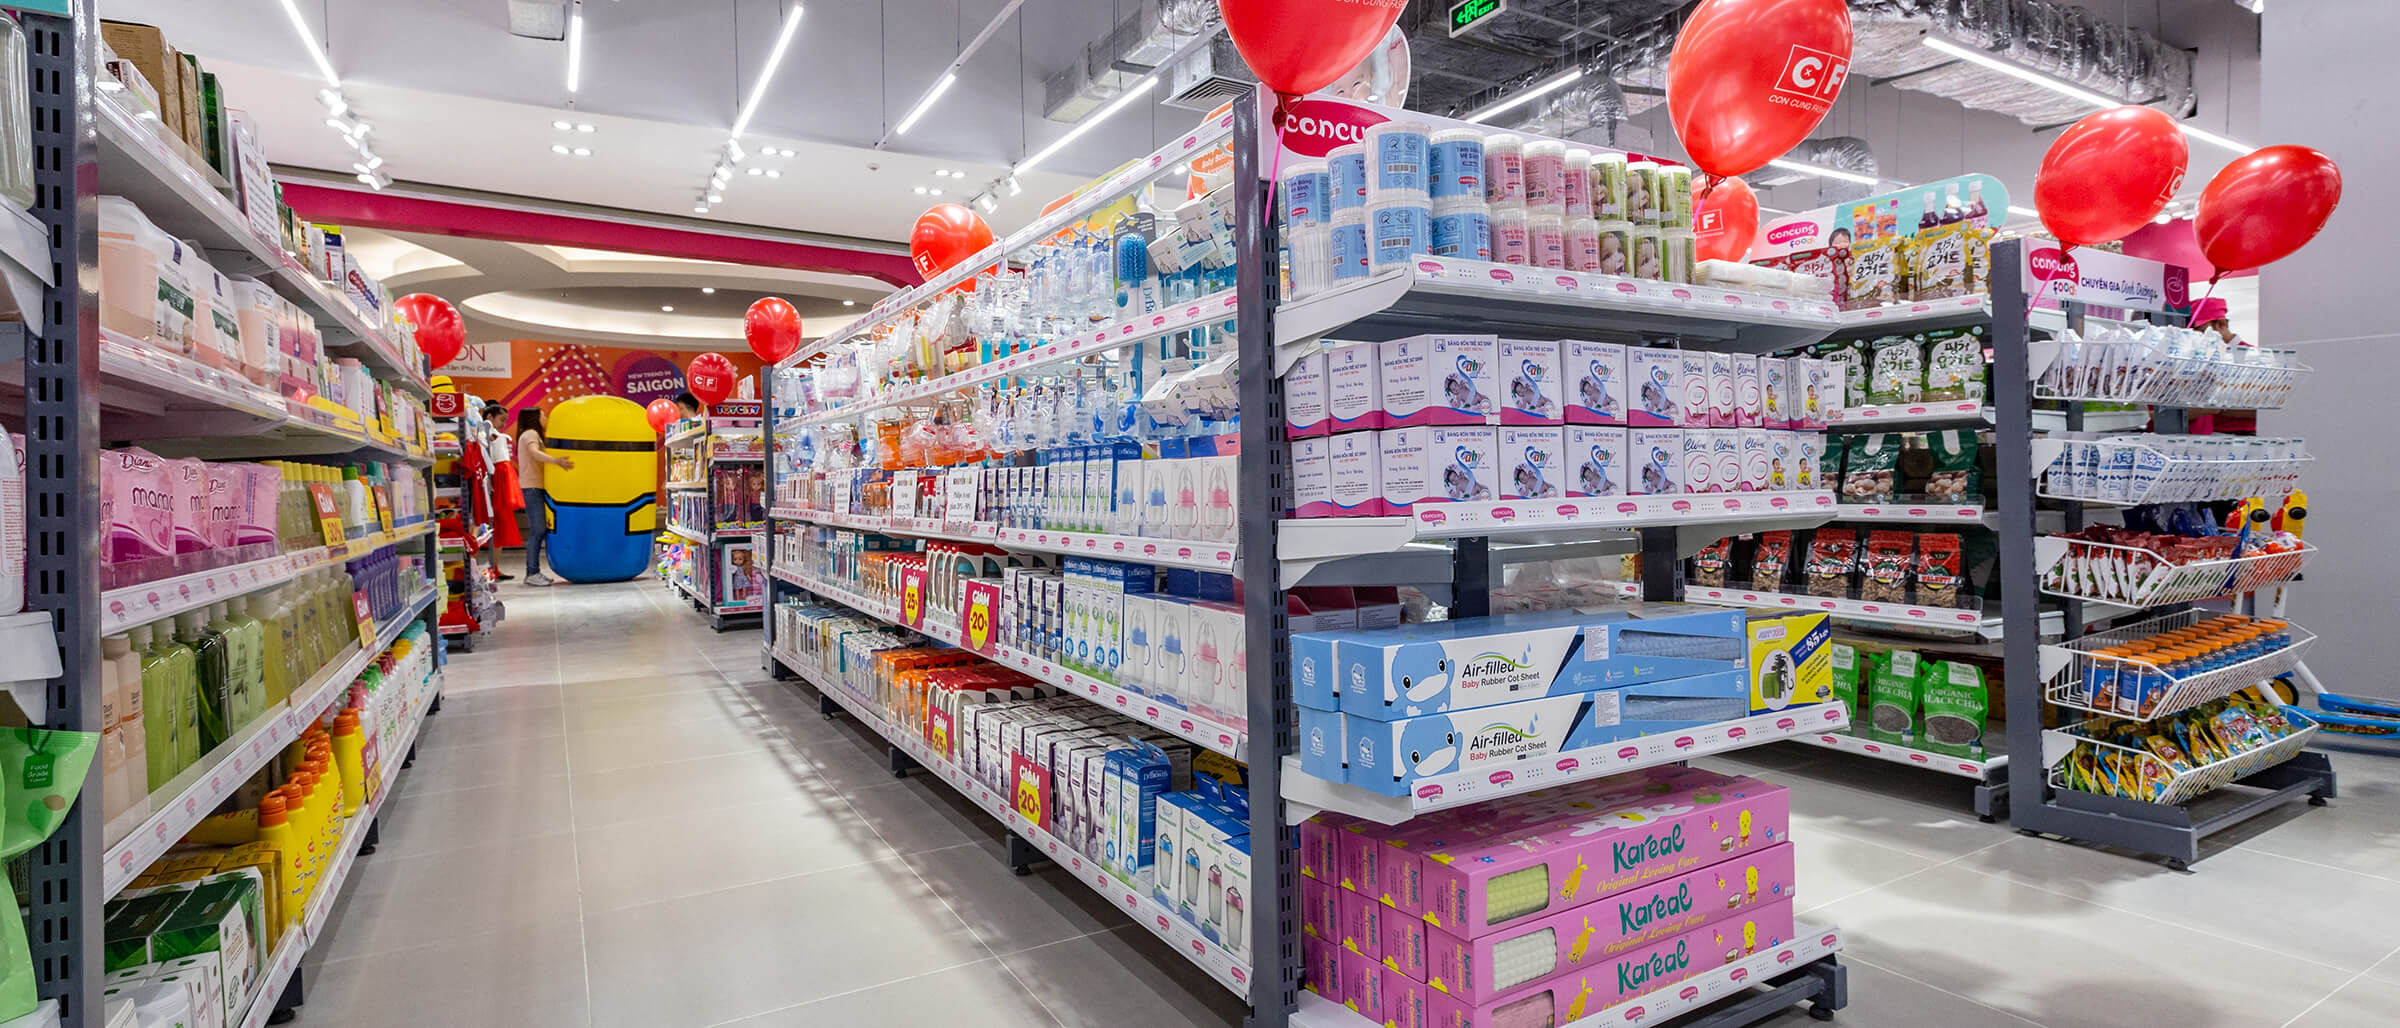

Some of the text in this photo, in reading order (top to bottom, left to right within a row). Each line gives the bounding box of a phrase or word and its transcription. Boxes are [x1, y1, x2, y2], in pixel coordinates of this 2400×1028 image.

[1478, 2, 1495, 16] EXIT
[1768, 95, 1789, 105] CON
[1790, 99, 1812, 111] CUNG
[1769, 224, 1816, 241] concung
[2081, 277, 2108, 290] CHUYÊN
[2110, 281, 2121, 291] GIA
[626, 376, 685, 394] SAIGON
[972, 586, 990, 606] GIẢM
[1806, 631, 1820, 651] 85
[1461, 659, 1516, 678] Air-filled
[1461, 671, 1540, 689] Baby Rubber Cot Sheet
[1930, 687, 1973, 698] ORGANIC
[1955, 695, 1983, 711] CHIA
[1470, 728, 1523, 750] Air-filled
[1469, 752, 1488, 761] Baby
[1488, 747, 1514, 758] Rubber
[1515, 745, 1527, 754] Cot
[1527, 740, 1547, 751] Sheet
[27, 770, 49, 778] Grade
[1613, 823, 1686, 874] Kareal
[1596, 870, 1640, 893] Original
[1640, 862, 1676, 880] Loving
[1619, 881, 1693, 936] Kareal
[1603, 928, 1647, 954] Original
[1648, 922, 1683, 939] Loving
[1617, 939, 1690, 995] Kareal
